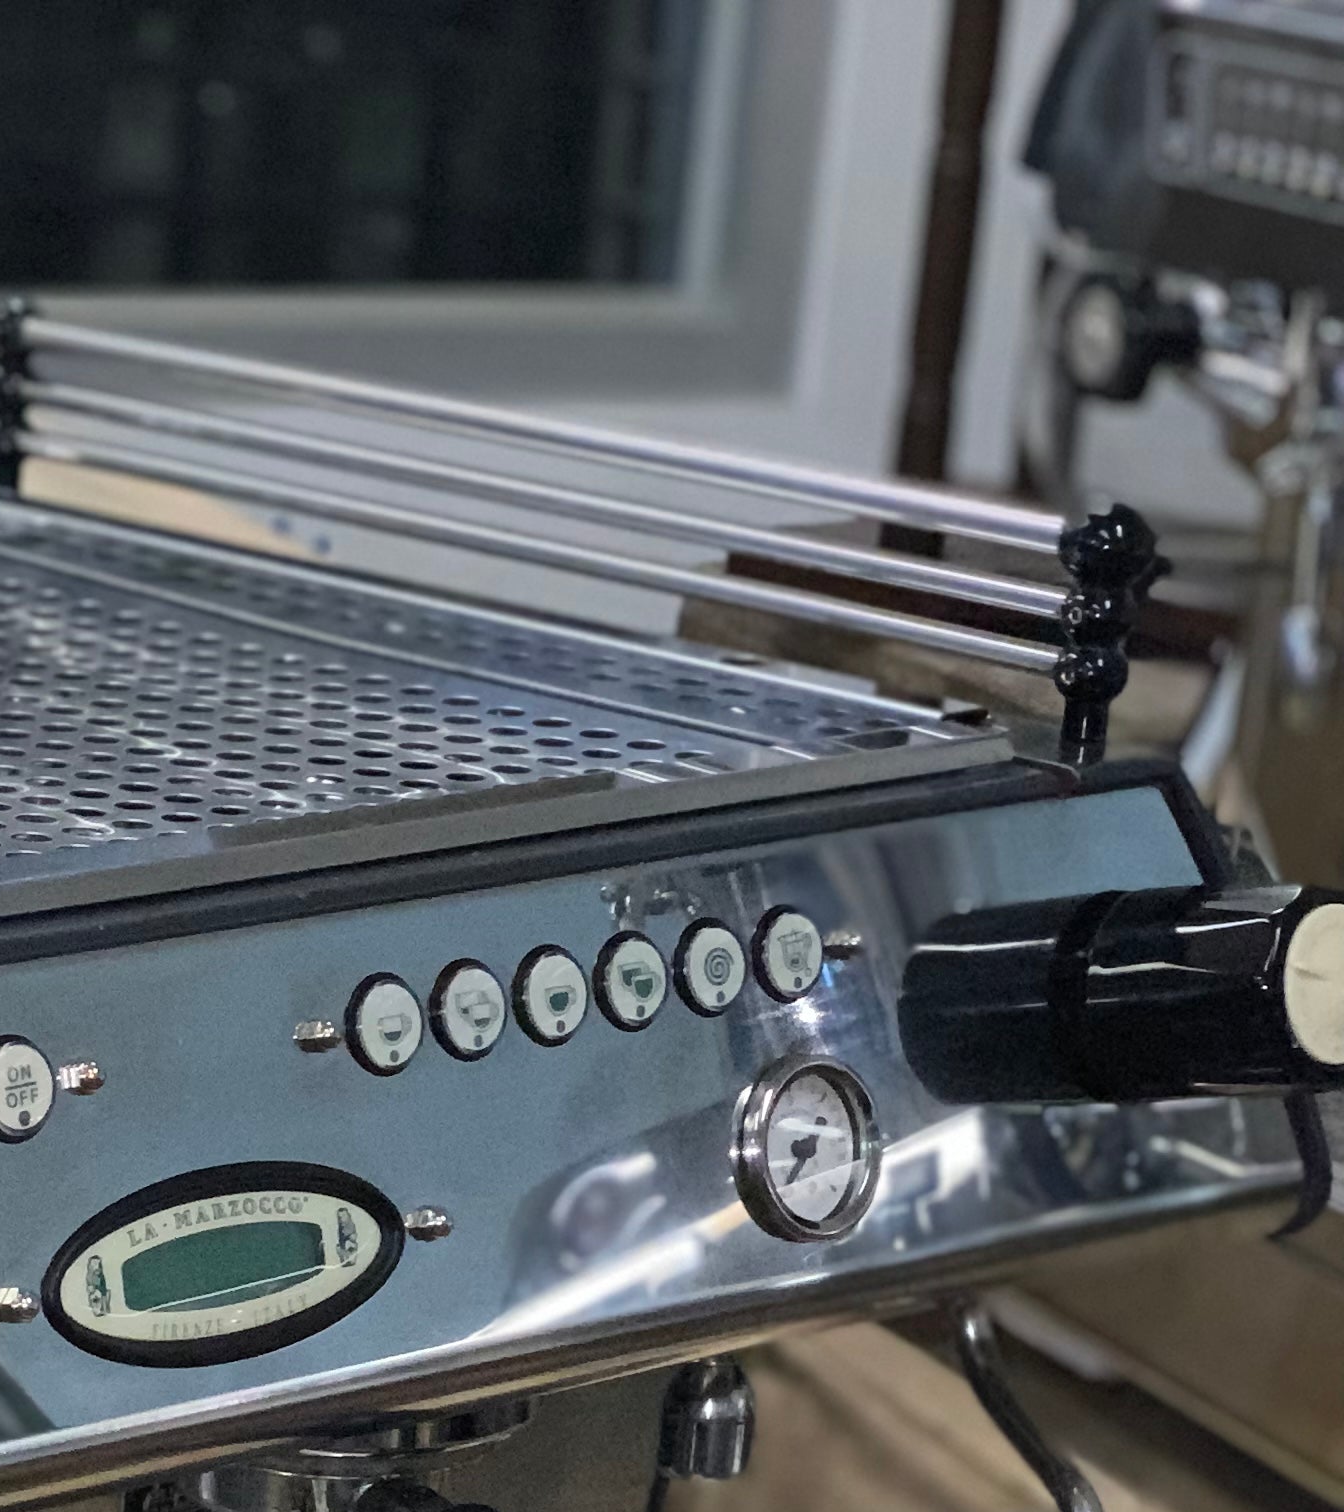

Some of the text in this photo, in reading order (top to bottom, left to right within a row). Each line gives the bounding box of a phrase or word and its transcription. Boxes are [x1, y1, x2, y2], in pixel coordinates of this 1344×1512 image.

[7, 1064, 32, 1083] ON
[5, 1087, 39, 1109] OFF
[126, 1196, 304, 1248] LA MARZOCCO
[150, 1293, 308, 1341] FIRENZE ITALY
